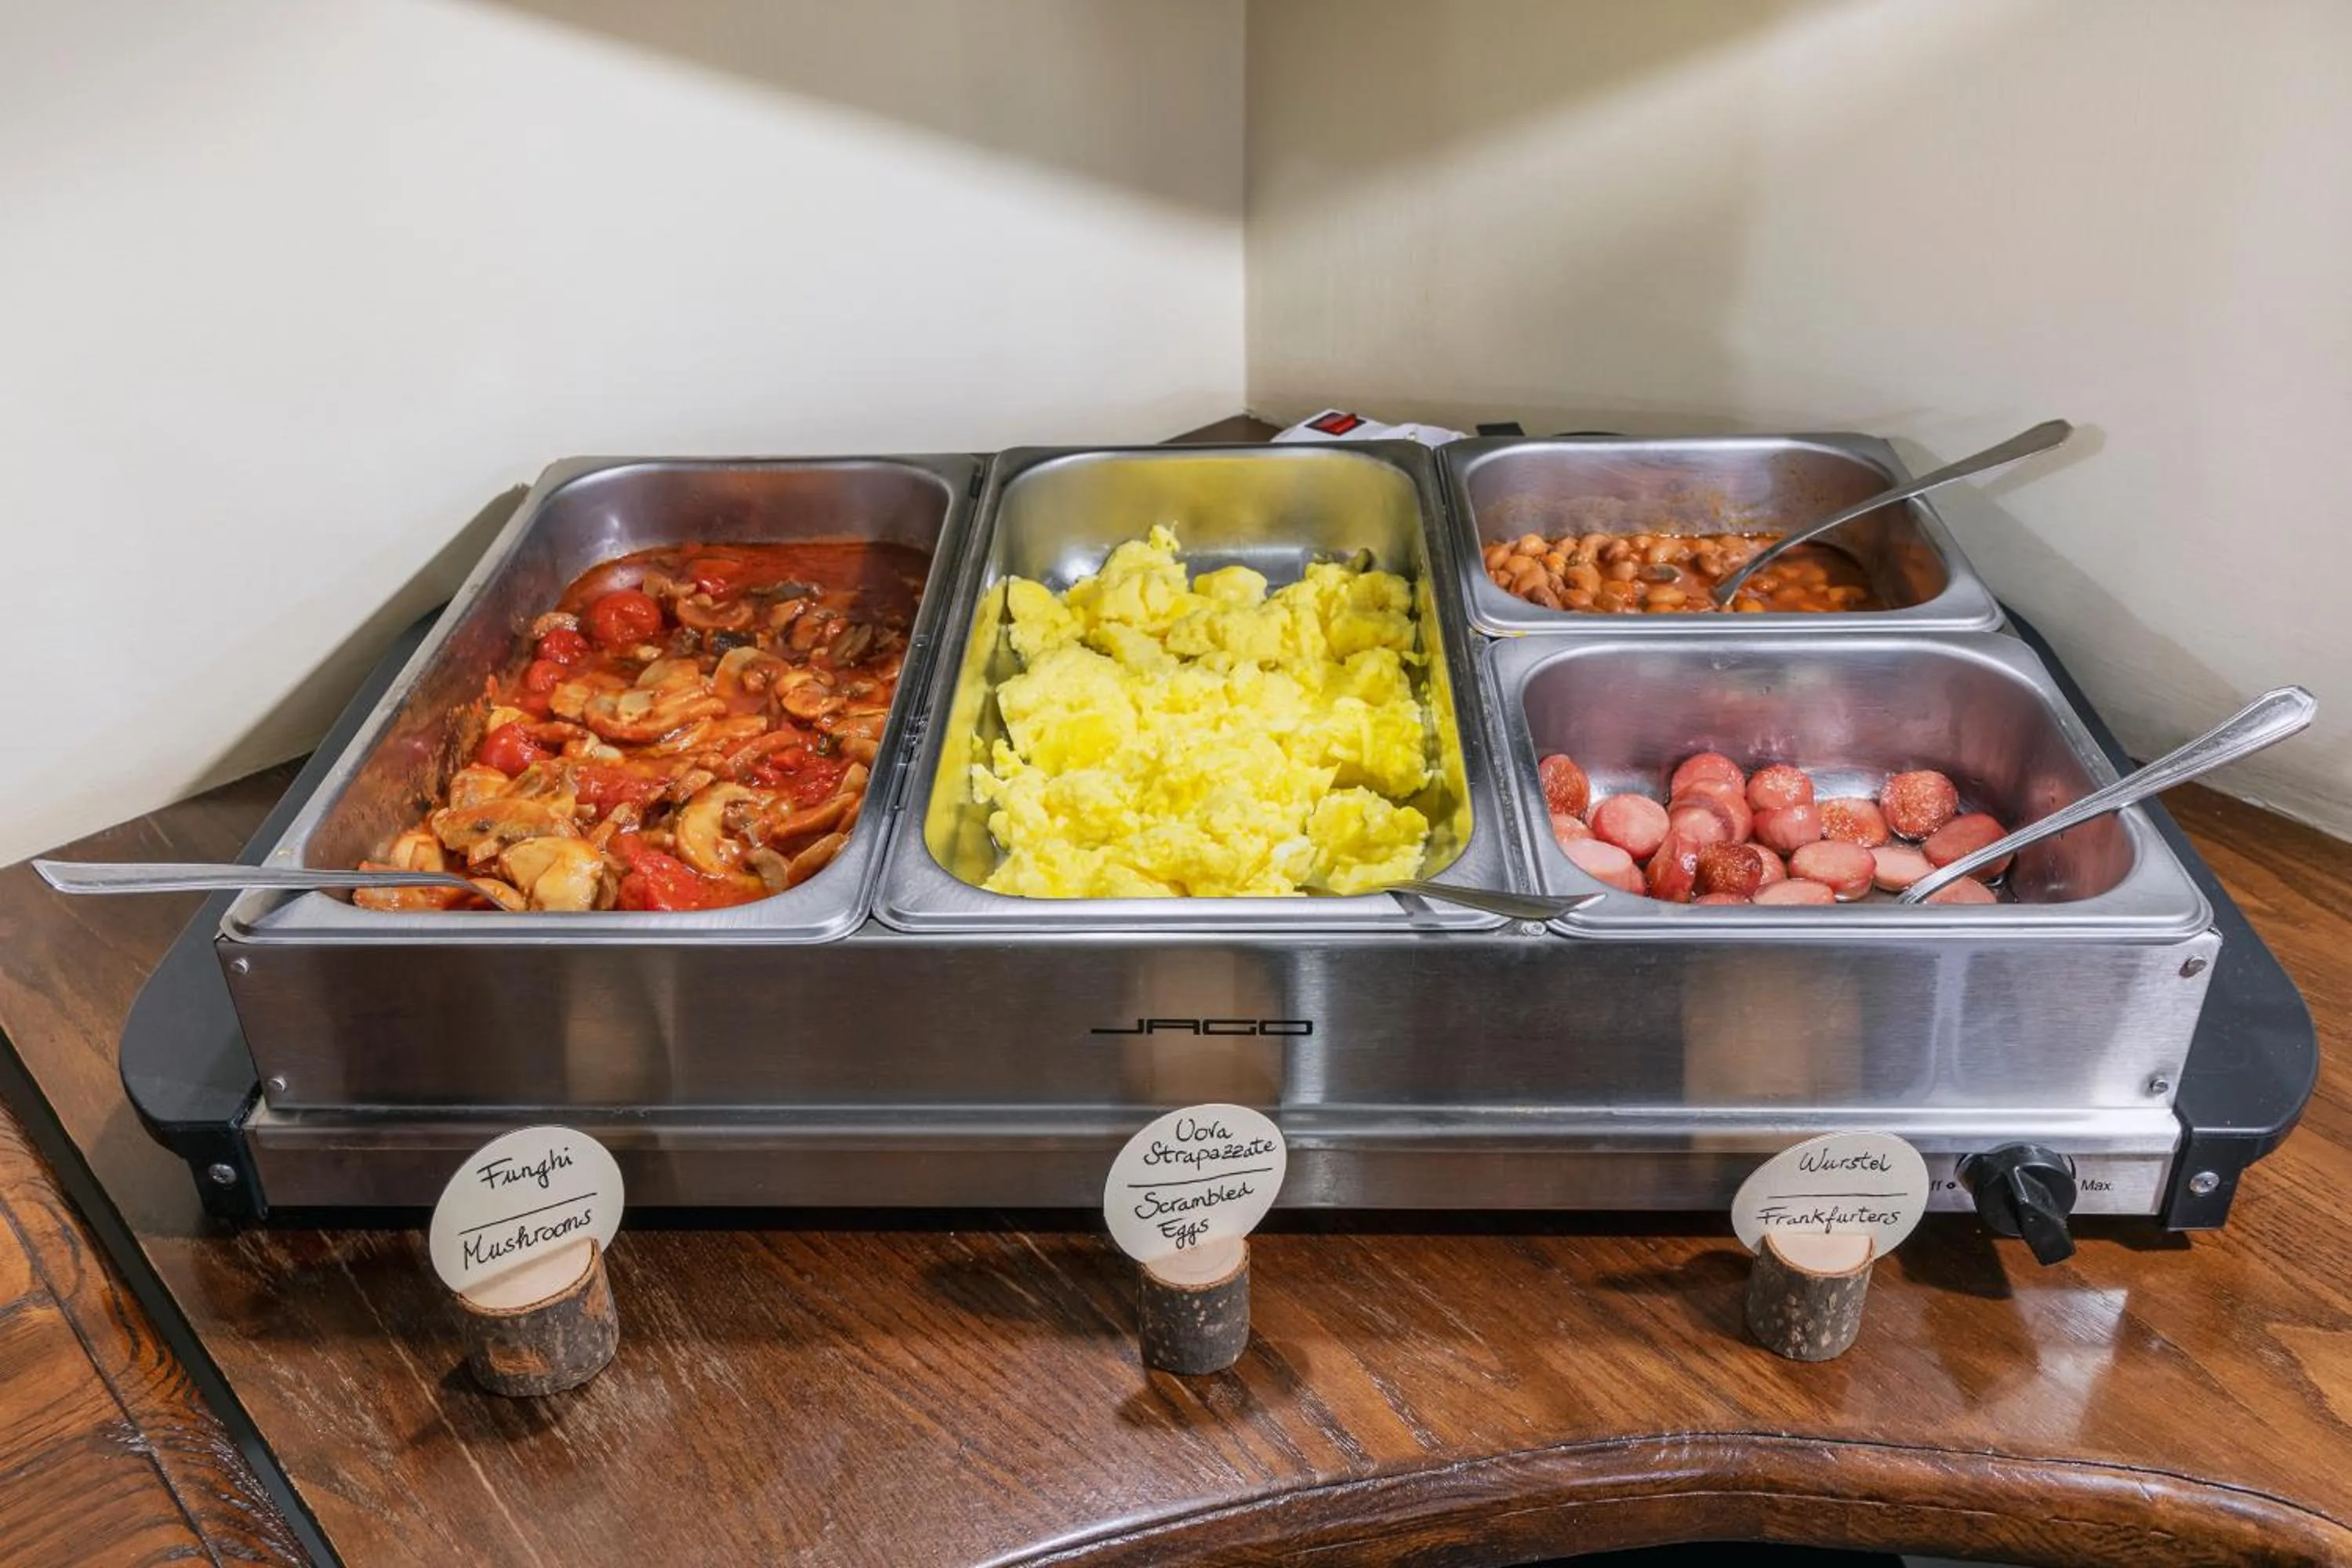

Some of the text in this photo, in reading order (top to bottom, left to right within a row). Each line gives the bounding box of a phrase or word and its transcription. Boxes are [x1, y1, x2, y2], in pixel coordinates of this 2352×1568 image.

[1091, 1019, 1312, 1035] JAGO
[1175, 1118, 1233, 1142] Uova
[476, 1146, 573, 1189] Funghi
[1143, 1138, 1277, 1171] Strapazzate
[1799, 1147, 1892, 1172] Wurstel
[1931, 1179, 1943, 1191] ff
[2080, 1179, 2111, 1191] Max
[1134, 1182, 1254, 1219] Scrambled
[1156, 1218, 1209, 1250] Eggs
[1756, 1206, 1901, 1235] Frankfurters
[463, 1209, 592, 1271] Mushrooms
